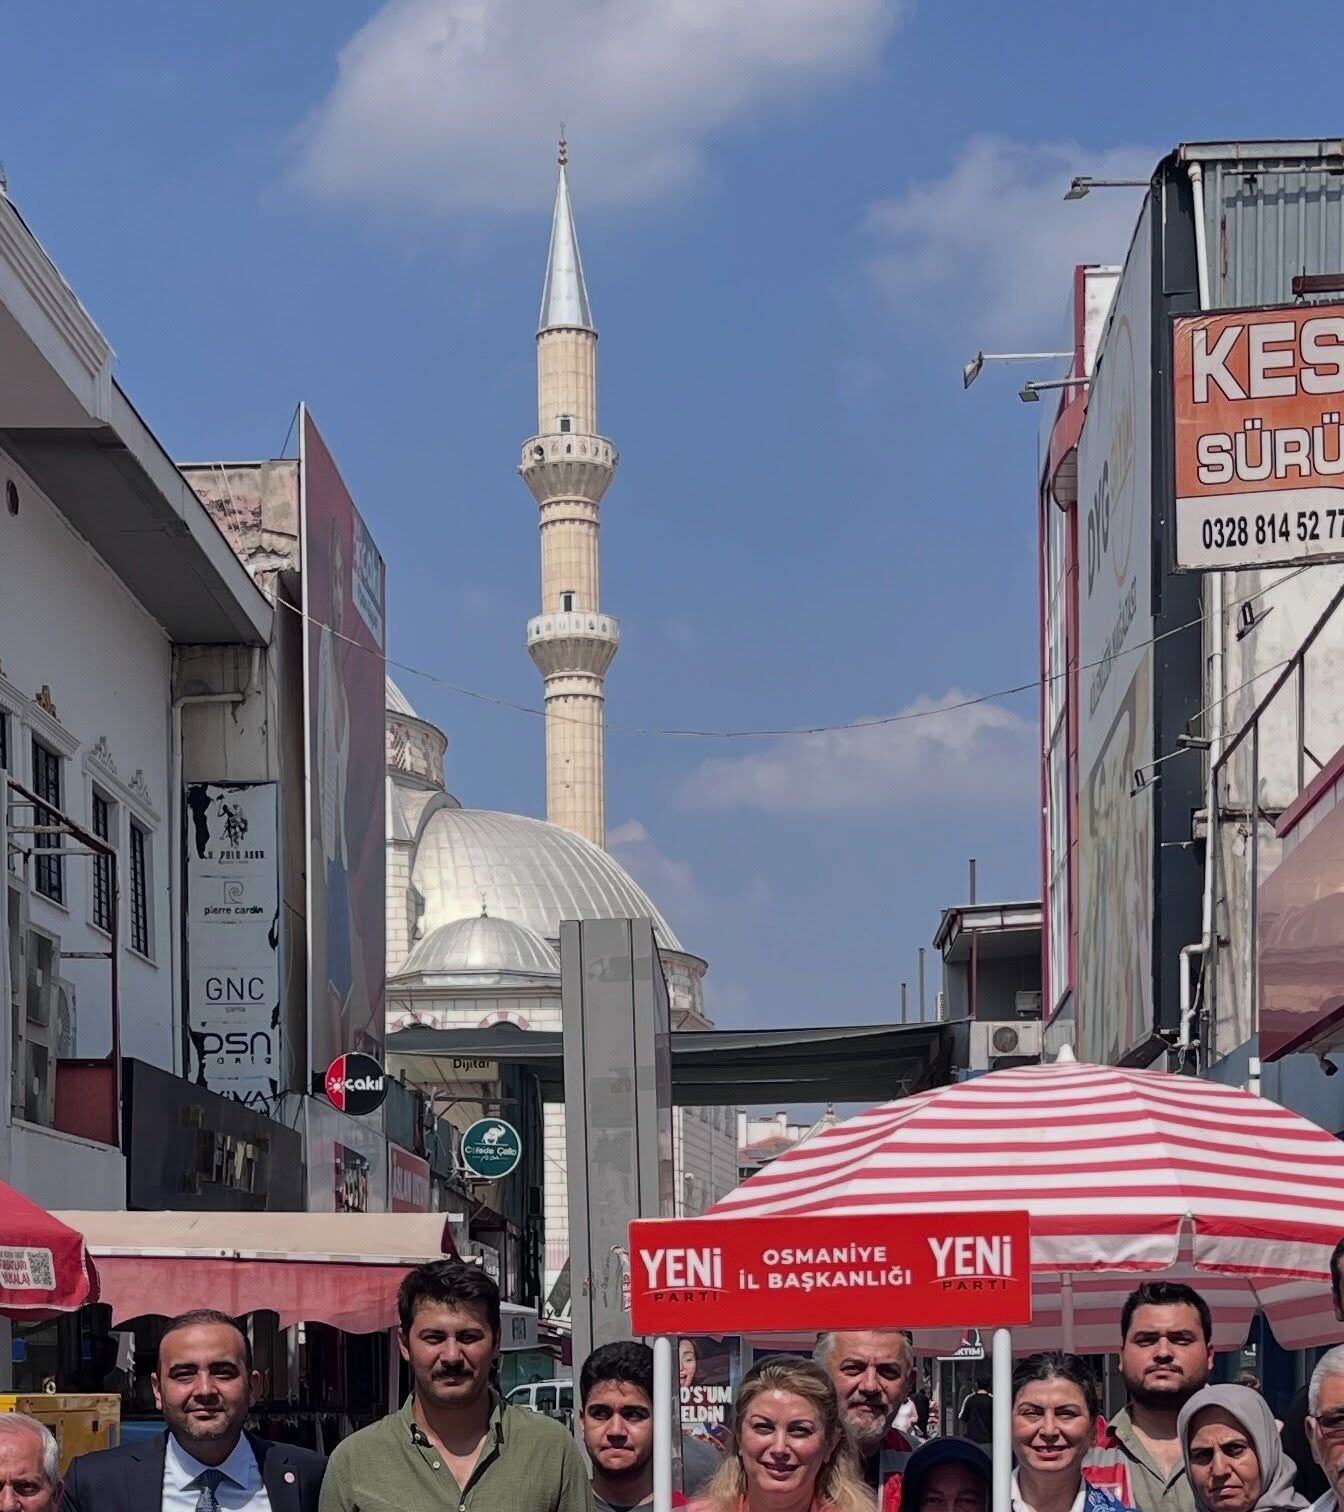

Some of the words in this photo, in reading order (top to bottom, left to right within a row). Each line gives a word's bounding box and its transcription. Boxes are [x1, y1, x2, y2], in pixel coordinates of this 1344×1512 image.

[1201, 513, 1249, 551] 0328
[1254, 511, 1290, 547] 814
[1297, 509, 1323, 543] 52
[206, 977, 264, 1000] GNC
[344, 1075, 385, 1092] çakıl
[763, 1241, 887, 1266] OSMANİYE
[739, 1268, 759, 1290] İL
[768, 1264, 912, 1293] BAŞKANLIĞI
[681, 1405, 725, 1423] ELDİN
